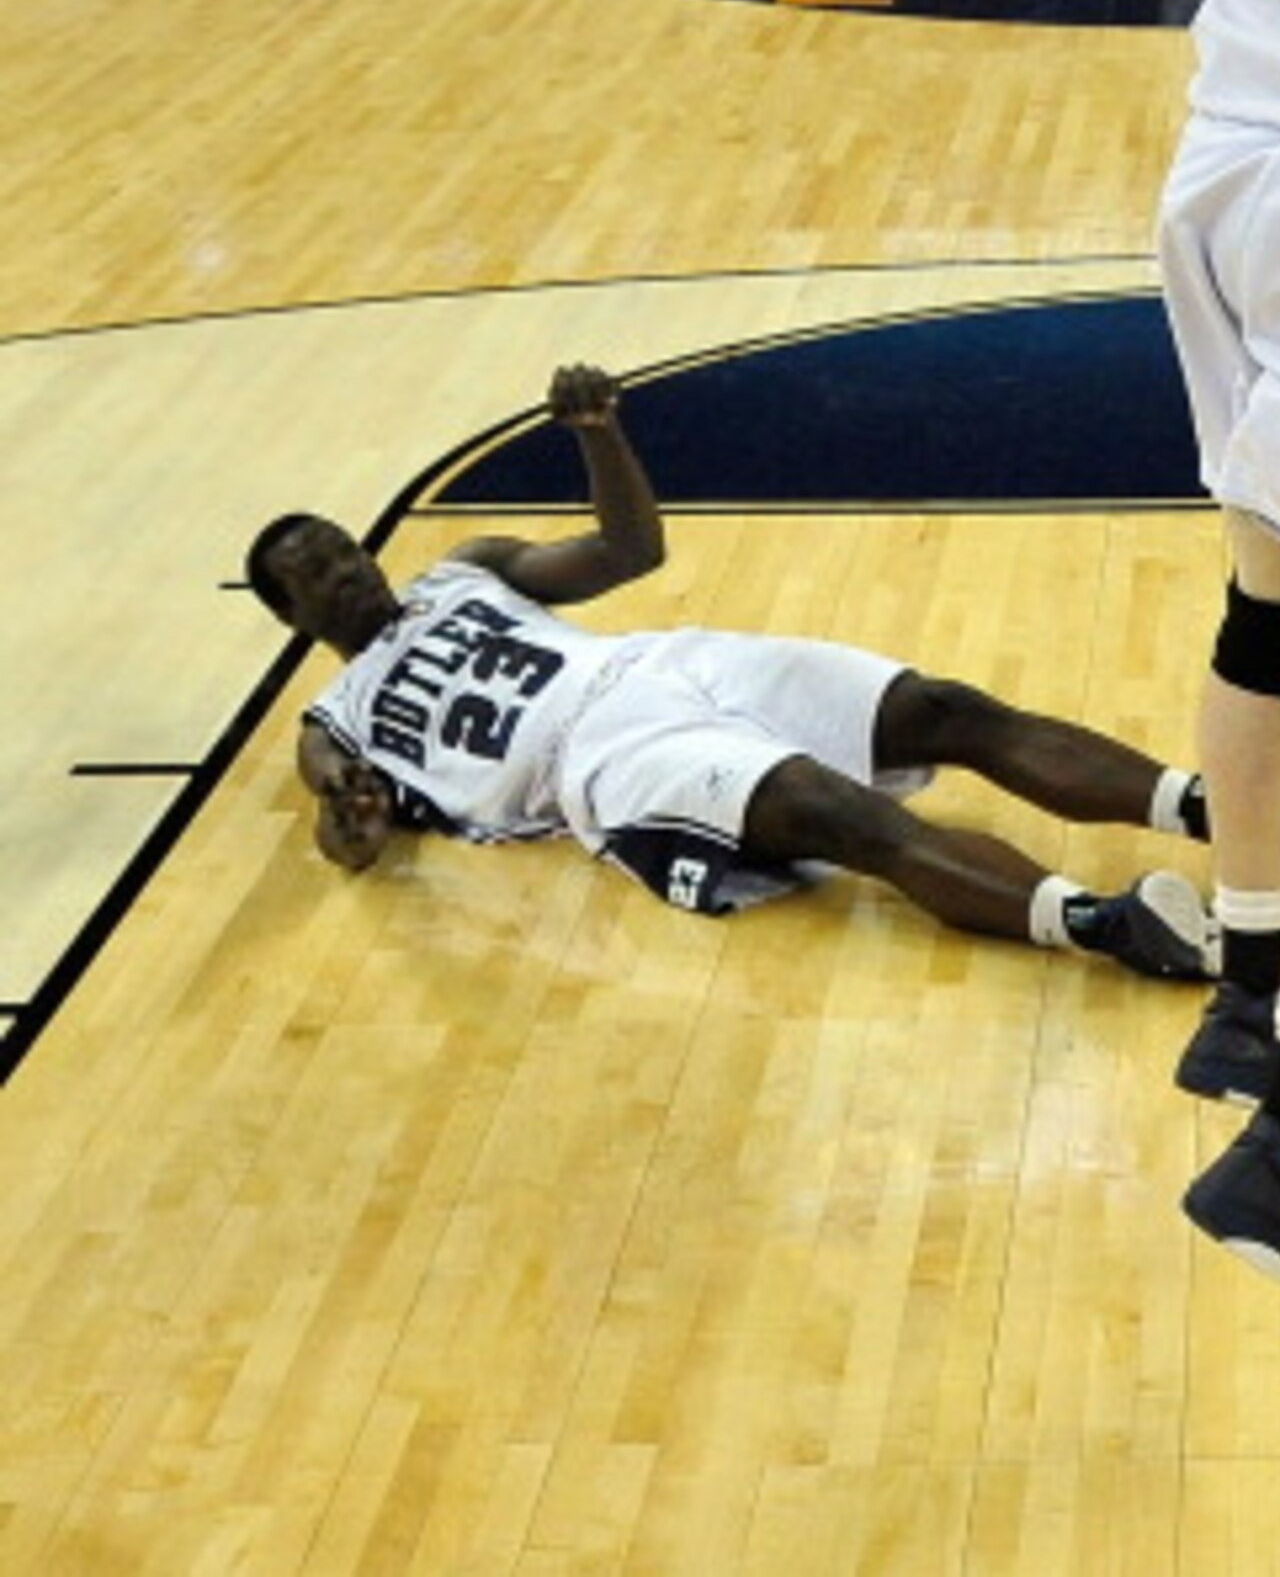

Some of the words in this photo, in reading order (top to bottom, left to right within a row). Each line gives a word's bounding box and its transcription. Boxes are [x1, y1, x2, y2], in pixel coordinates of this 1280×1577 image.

[371, 599, 524, 770] BUTLER
[440, 631, 565, 760] 23
[668, 857, 707, 910] 23
